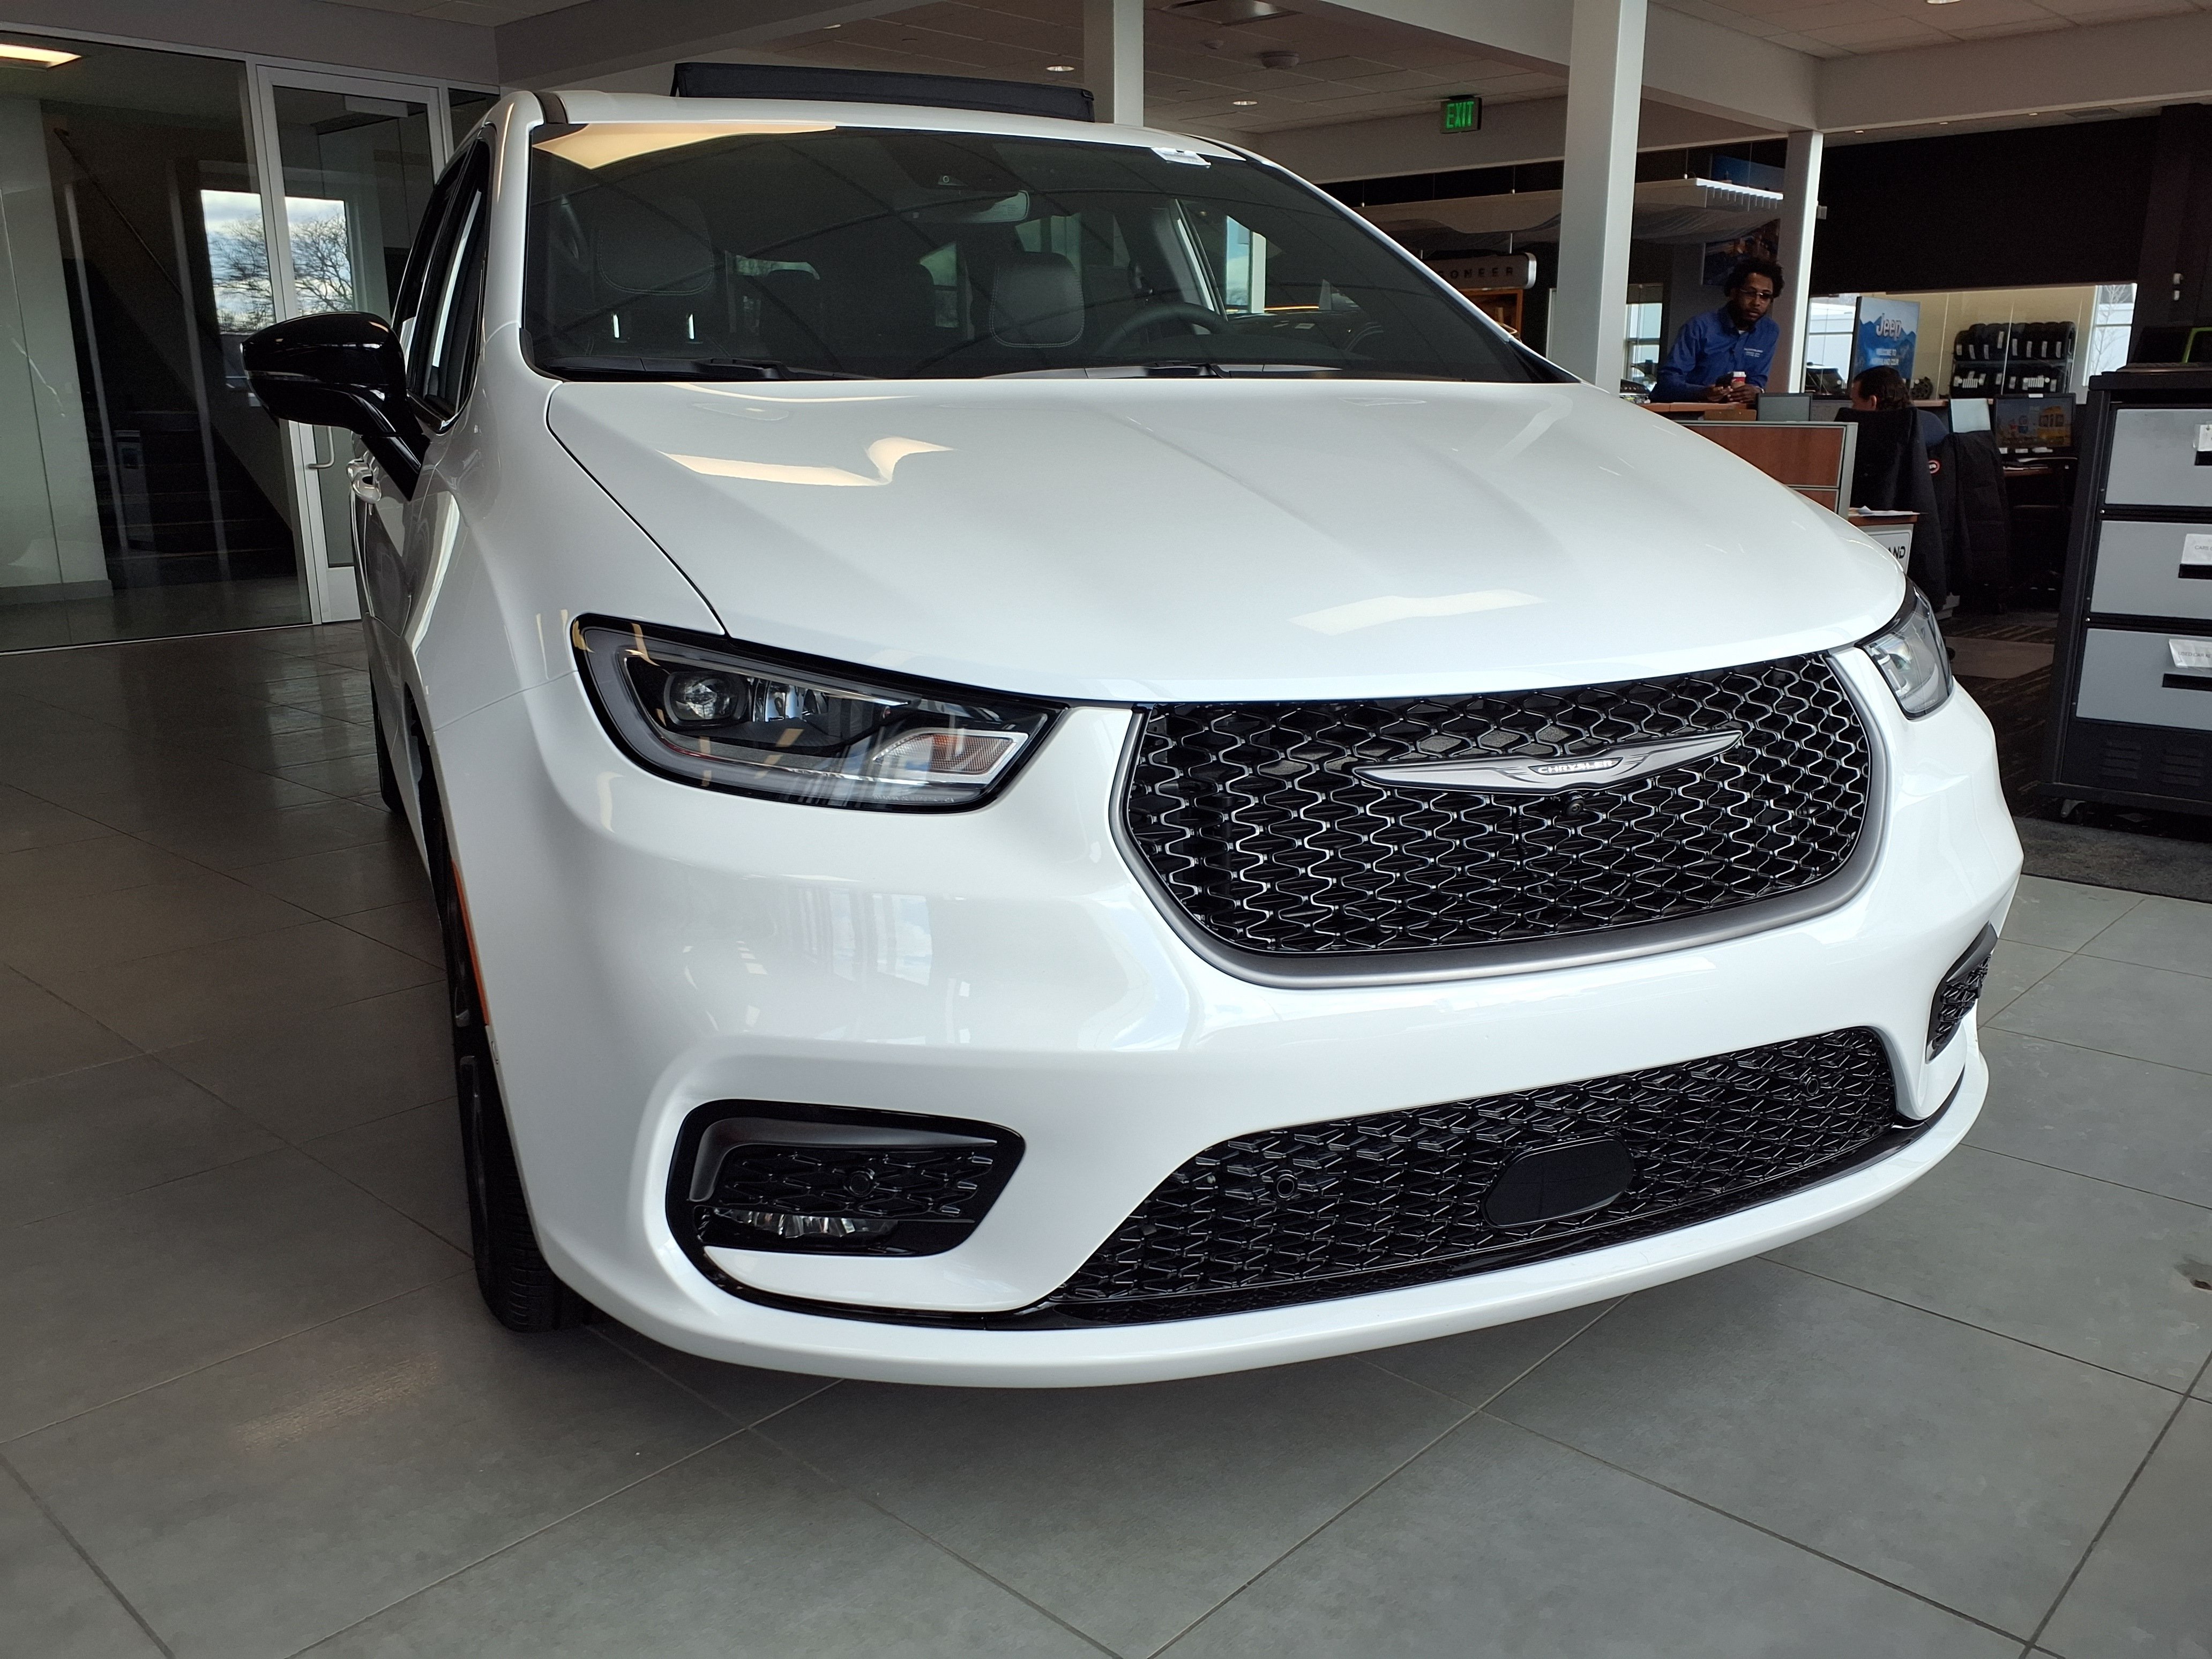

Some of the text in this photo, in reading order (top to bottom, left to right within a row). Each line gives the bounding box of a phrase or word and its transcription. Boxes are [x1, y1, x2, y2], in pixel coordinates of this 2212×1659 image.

[1446, 101, 1474, 129] EXIT
[1876, 313, 1902, 341] Jeep
[1538, 760, 1613, 774] CHRYSLER
